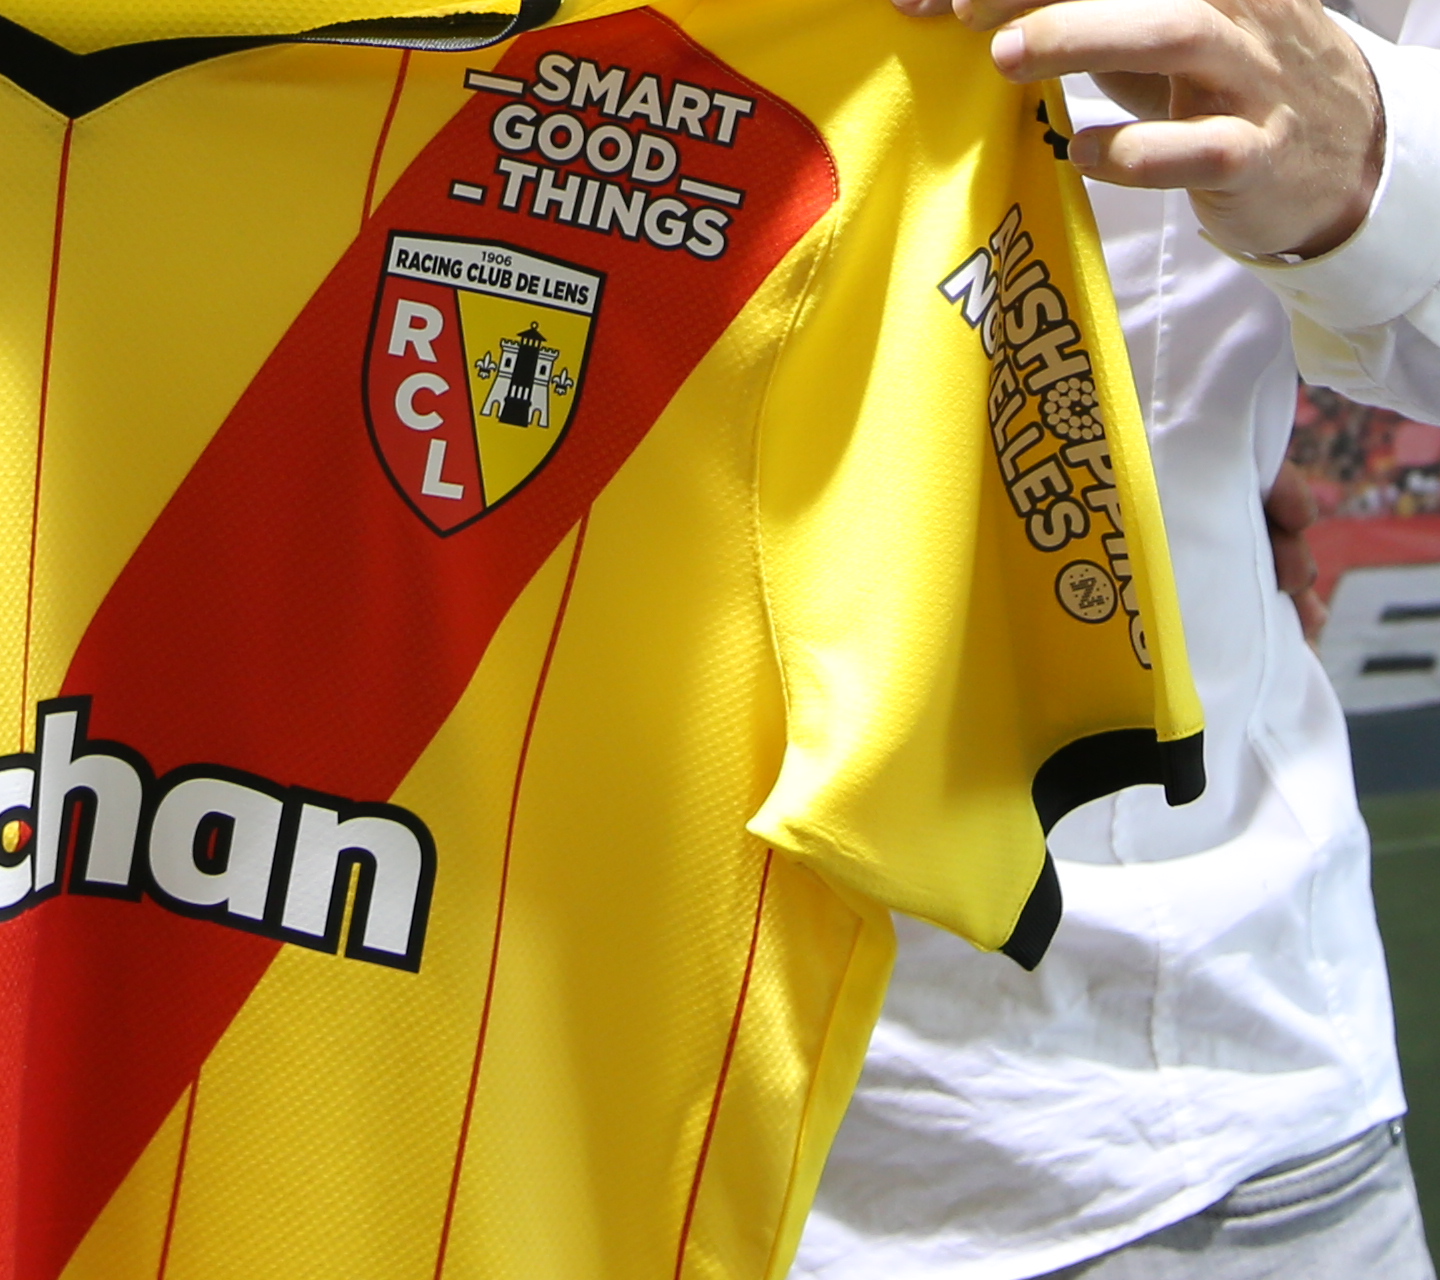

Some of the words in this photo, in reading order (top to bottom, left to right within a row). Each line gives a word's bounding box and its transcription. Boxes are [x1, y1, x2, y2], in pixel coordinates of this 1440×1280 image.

[531, 53, 753, 144] SMART
[492, 103, 678, 183] GOOD
[496, 157, 729, 258] THINGS
[396, 249, 462, 280] RACING
[466, 262, 512, 289] CLUB
[516, 271, 539, 296] DE
[542, 279, 590, 306] LENS
[481, 251, 513, 267] 1906
